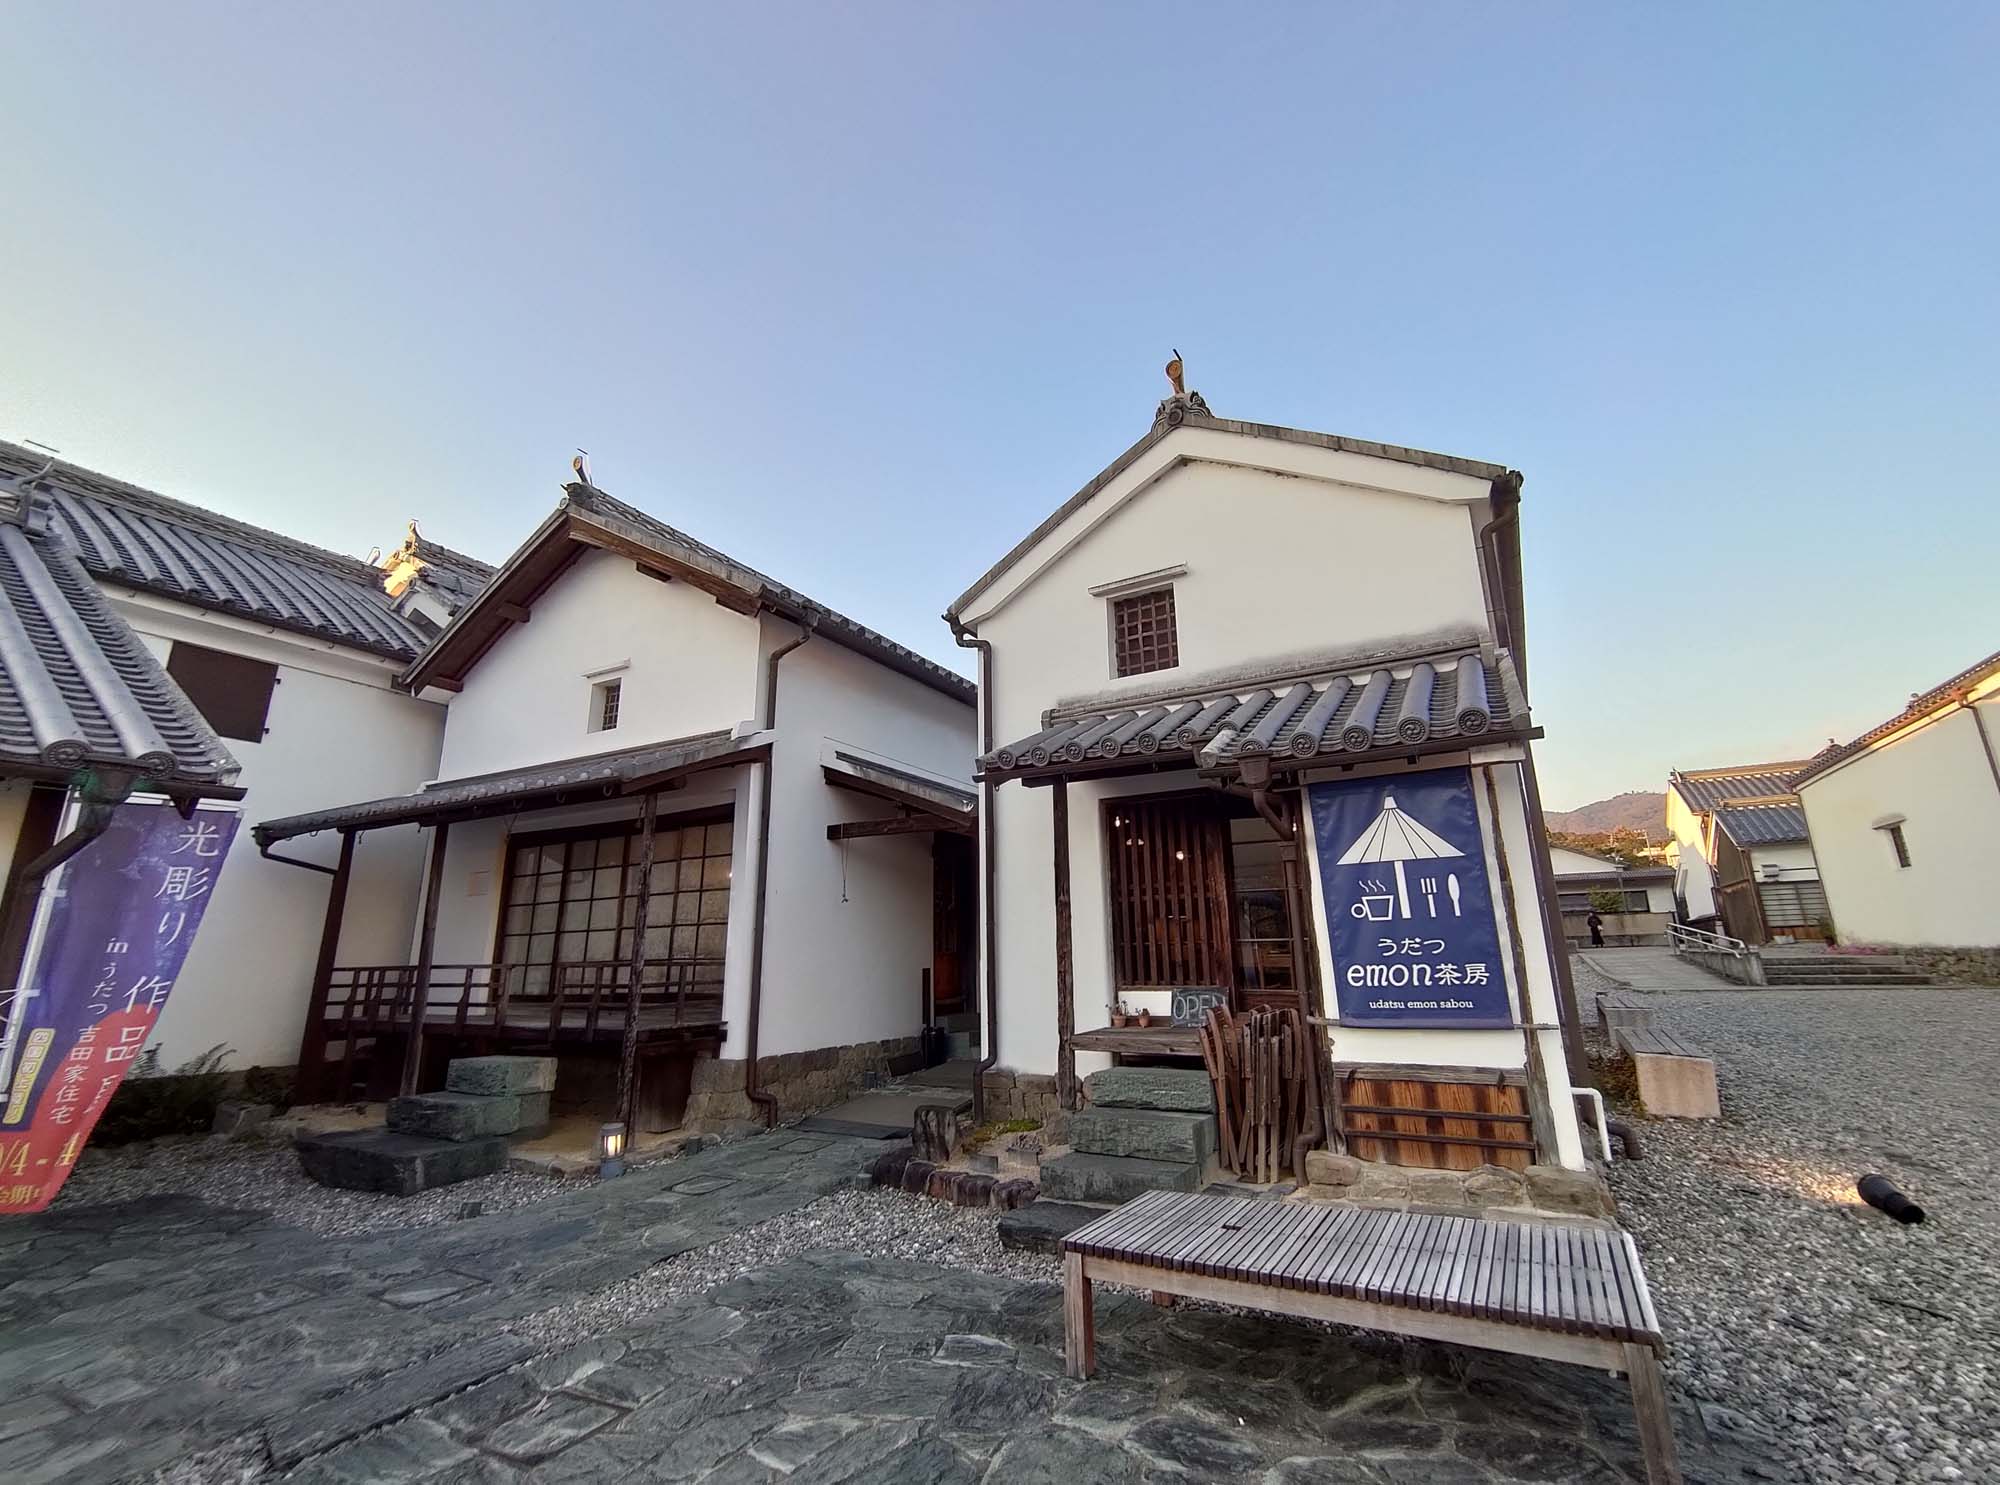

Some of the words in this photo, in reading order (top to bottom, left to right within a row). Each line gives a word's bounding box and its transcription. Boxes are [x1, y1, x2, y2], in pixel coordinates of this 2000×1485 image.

[105, 938, 129, 953] in
[1377, 937, 1445, 956] うだつ
[1369, 999, 1405, 1009] udatsu
[1407, 1001, 1438, 1009] emon
[1440, 998, 1474, 1009] sabou
